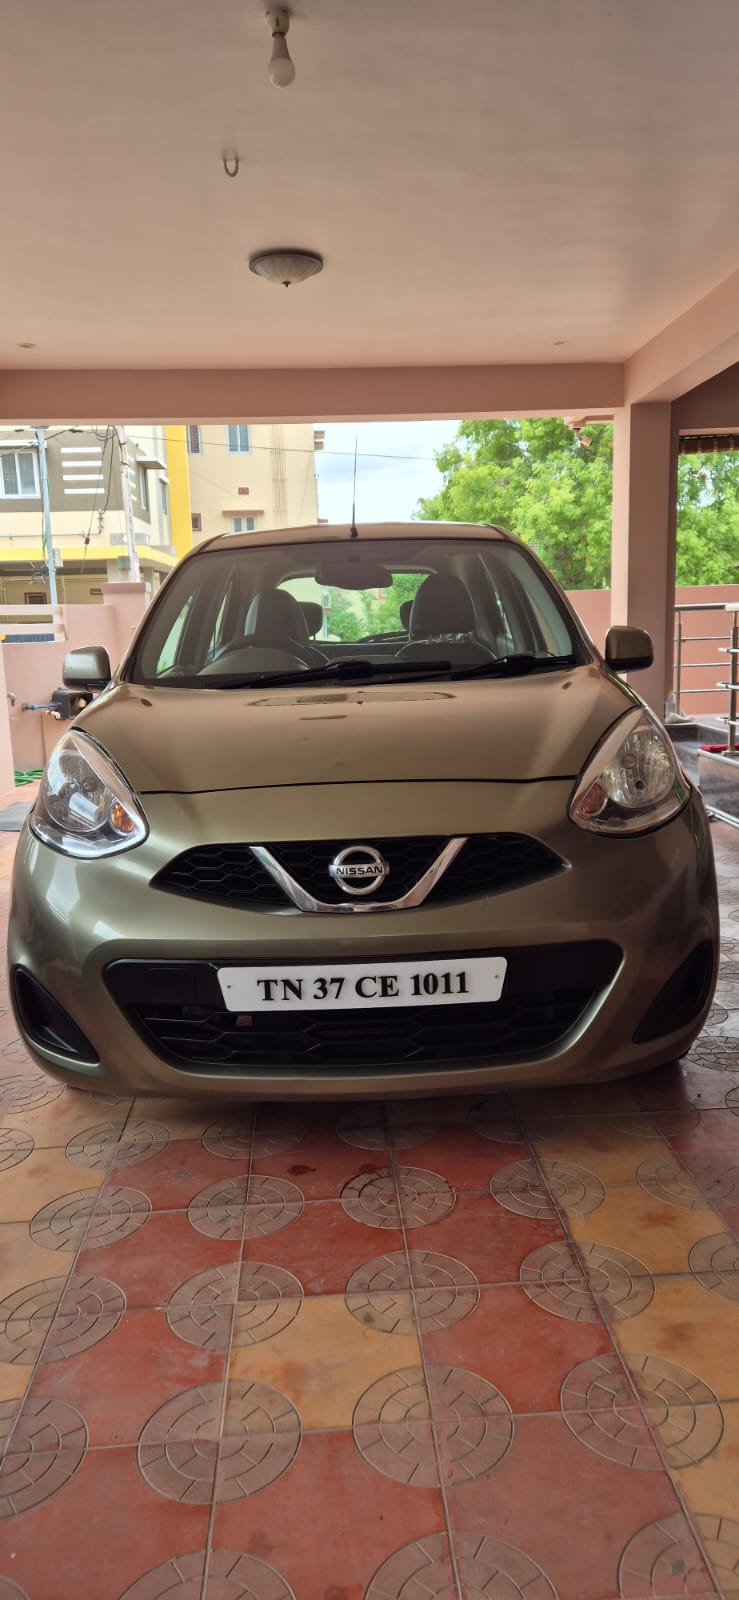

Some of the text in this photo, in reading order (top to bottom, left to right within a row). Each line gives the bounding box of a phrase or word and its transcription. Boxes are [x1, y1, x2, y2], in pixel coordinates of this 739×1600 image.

[336, 866, 383, 875] NISSAN
[257, 971, 469, 1001] TN 37 CE 1011
